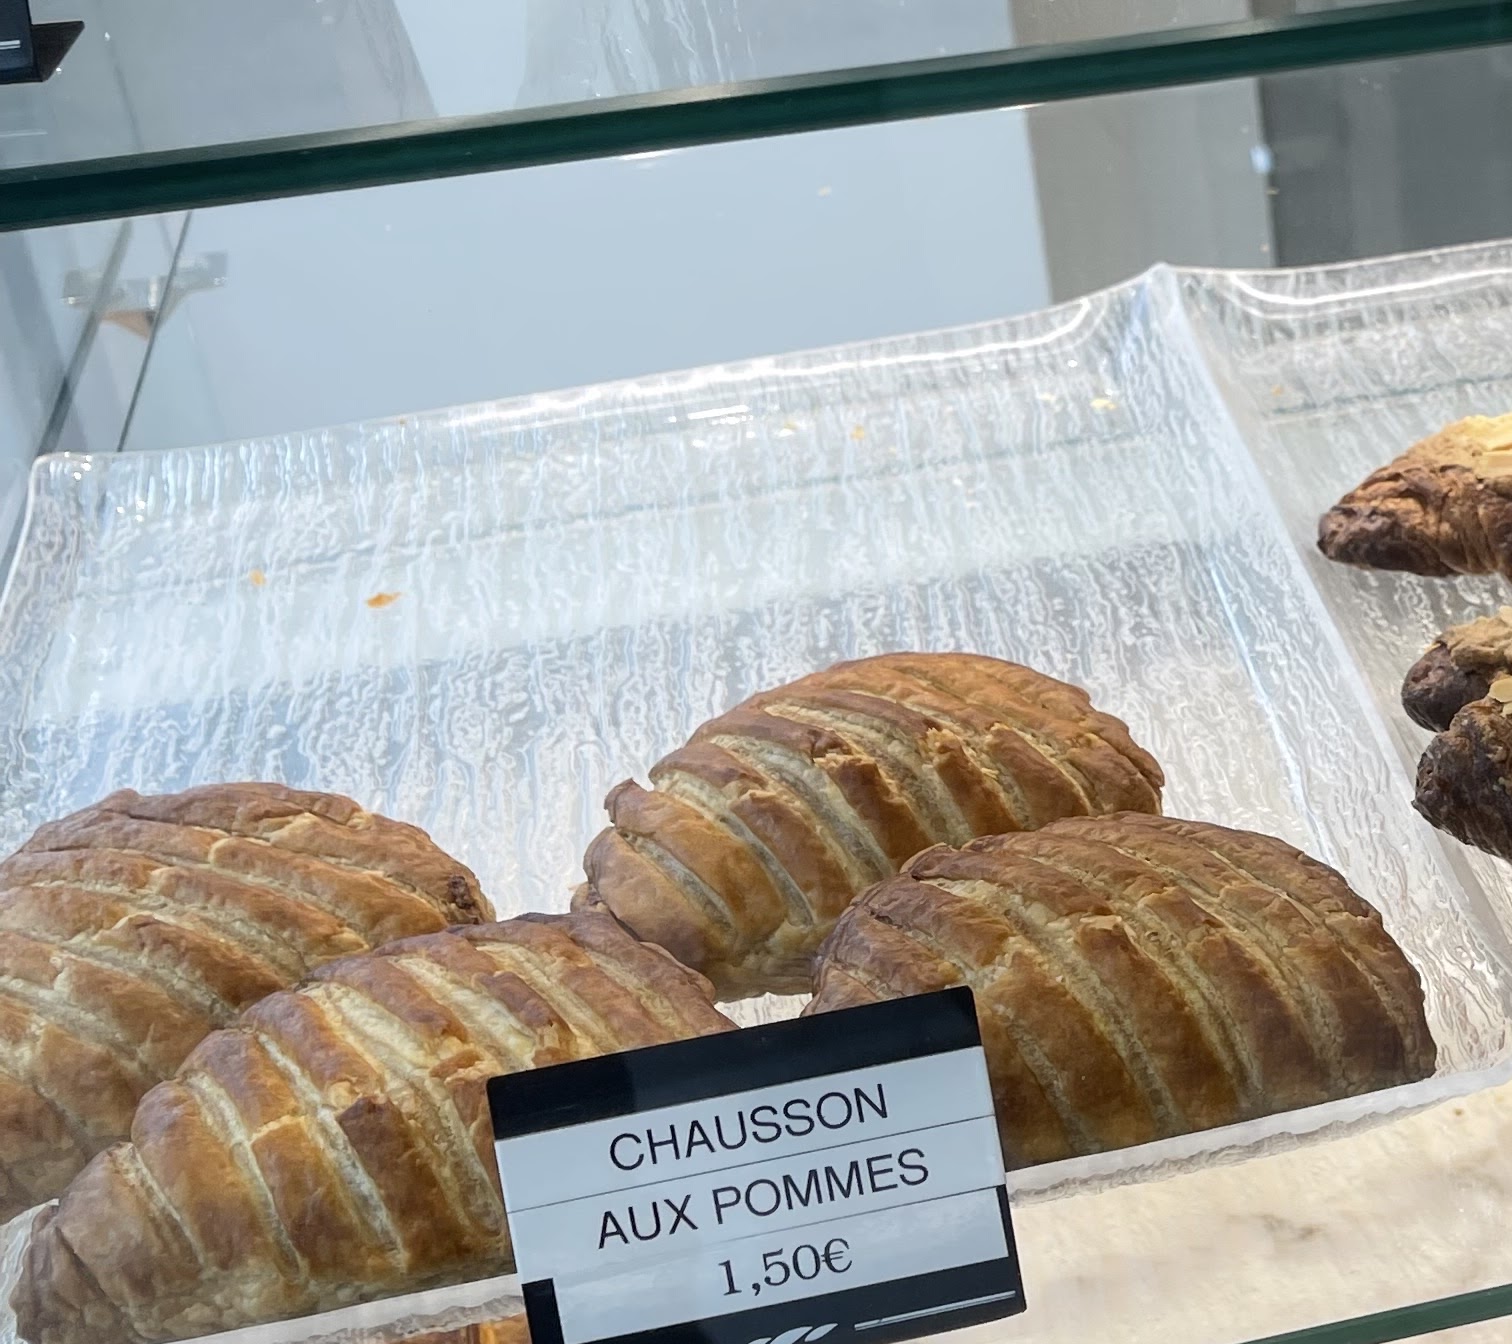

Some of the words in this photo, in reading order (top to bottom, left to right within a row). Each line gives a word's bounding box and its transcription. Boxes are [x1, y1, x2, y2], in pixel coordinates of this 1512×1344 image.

[608, 1082, 889, 1171] CHAUSSON
[598, 1194, 699, 1250] AUX
[711, 1147, 929, 1225] POMMES
[718, 1238, 853, 1297] 1,50€
